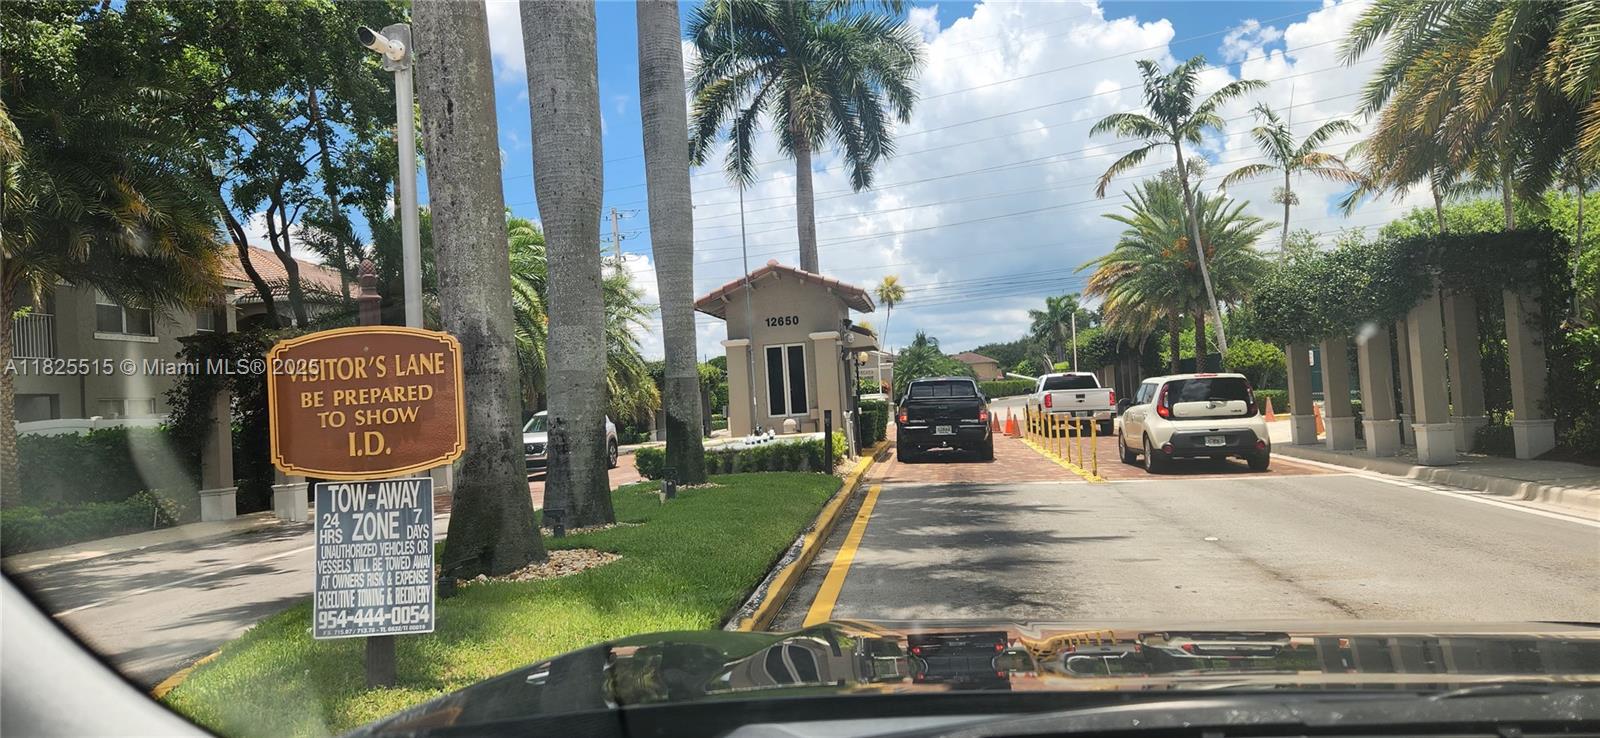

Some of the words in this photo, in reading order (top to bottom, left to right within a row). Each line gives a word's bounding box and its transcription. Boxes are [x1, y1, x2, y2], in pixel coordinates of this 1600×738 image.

[765, 315, 799, 327] 12650
[288, 355, 387, 382] VISITOR'S
[395, 352, 445, 377] LANE
[300, 391, 324, 408] BE
[333, 384, 433, 406] PREPARED
[317, 411, 346, 429] TO
[354, 406, 421, 426] SHOW
[348, 431, 392, 457] I.D.
[328, 481, 420, 513] TOW-AWAY
[323, 512, 340, 529] 24
[352, 511, 400, 541] ZONE
[413, 508, 423, 524] 7
[319, 528, 343, 545] HRS
[406, 524, 430, 540] DAYS
[321, 543, 378, 560] UNAUTHORIZED
[380, 541, 415, 556] VEHICLES
[417, 540, 428, 554] OR
[317, 560, 351, 575] VESSELS
[353, 558, 370, 573] WILL
[372, 558, 383, 571] BE
[385, 556, 411, 570] TOWED
[413, 554, 432, 569] AWAY
[321, 575, 330, 590] AT
[332, 573, 365, 589] OWNERS
[367, 572, 385, 587] RISK
[387, 571, 393, 586] &
[395, 570, 428, 585] EXPENSE
[318, 590, 355, 609] EXECUTIVE
[358, 588, 385, 607] TOWING
[387, 588, 393, 605] &
[395, 585, 431, 605] RECOVERY
[318, 605, 430, 629] 954-444-0054
